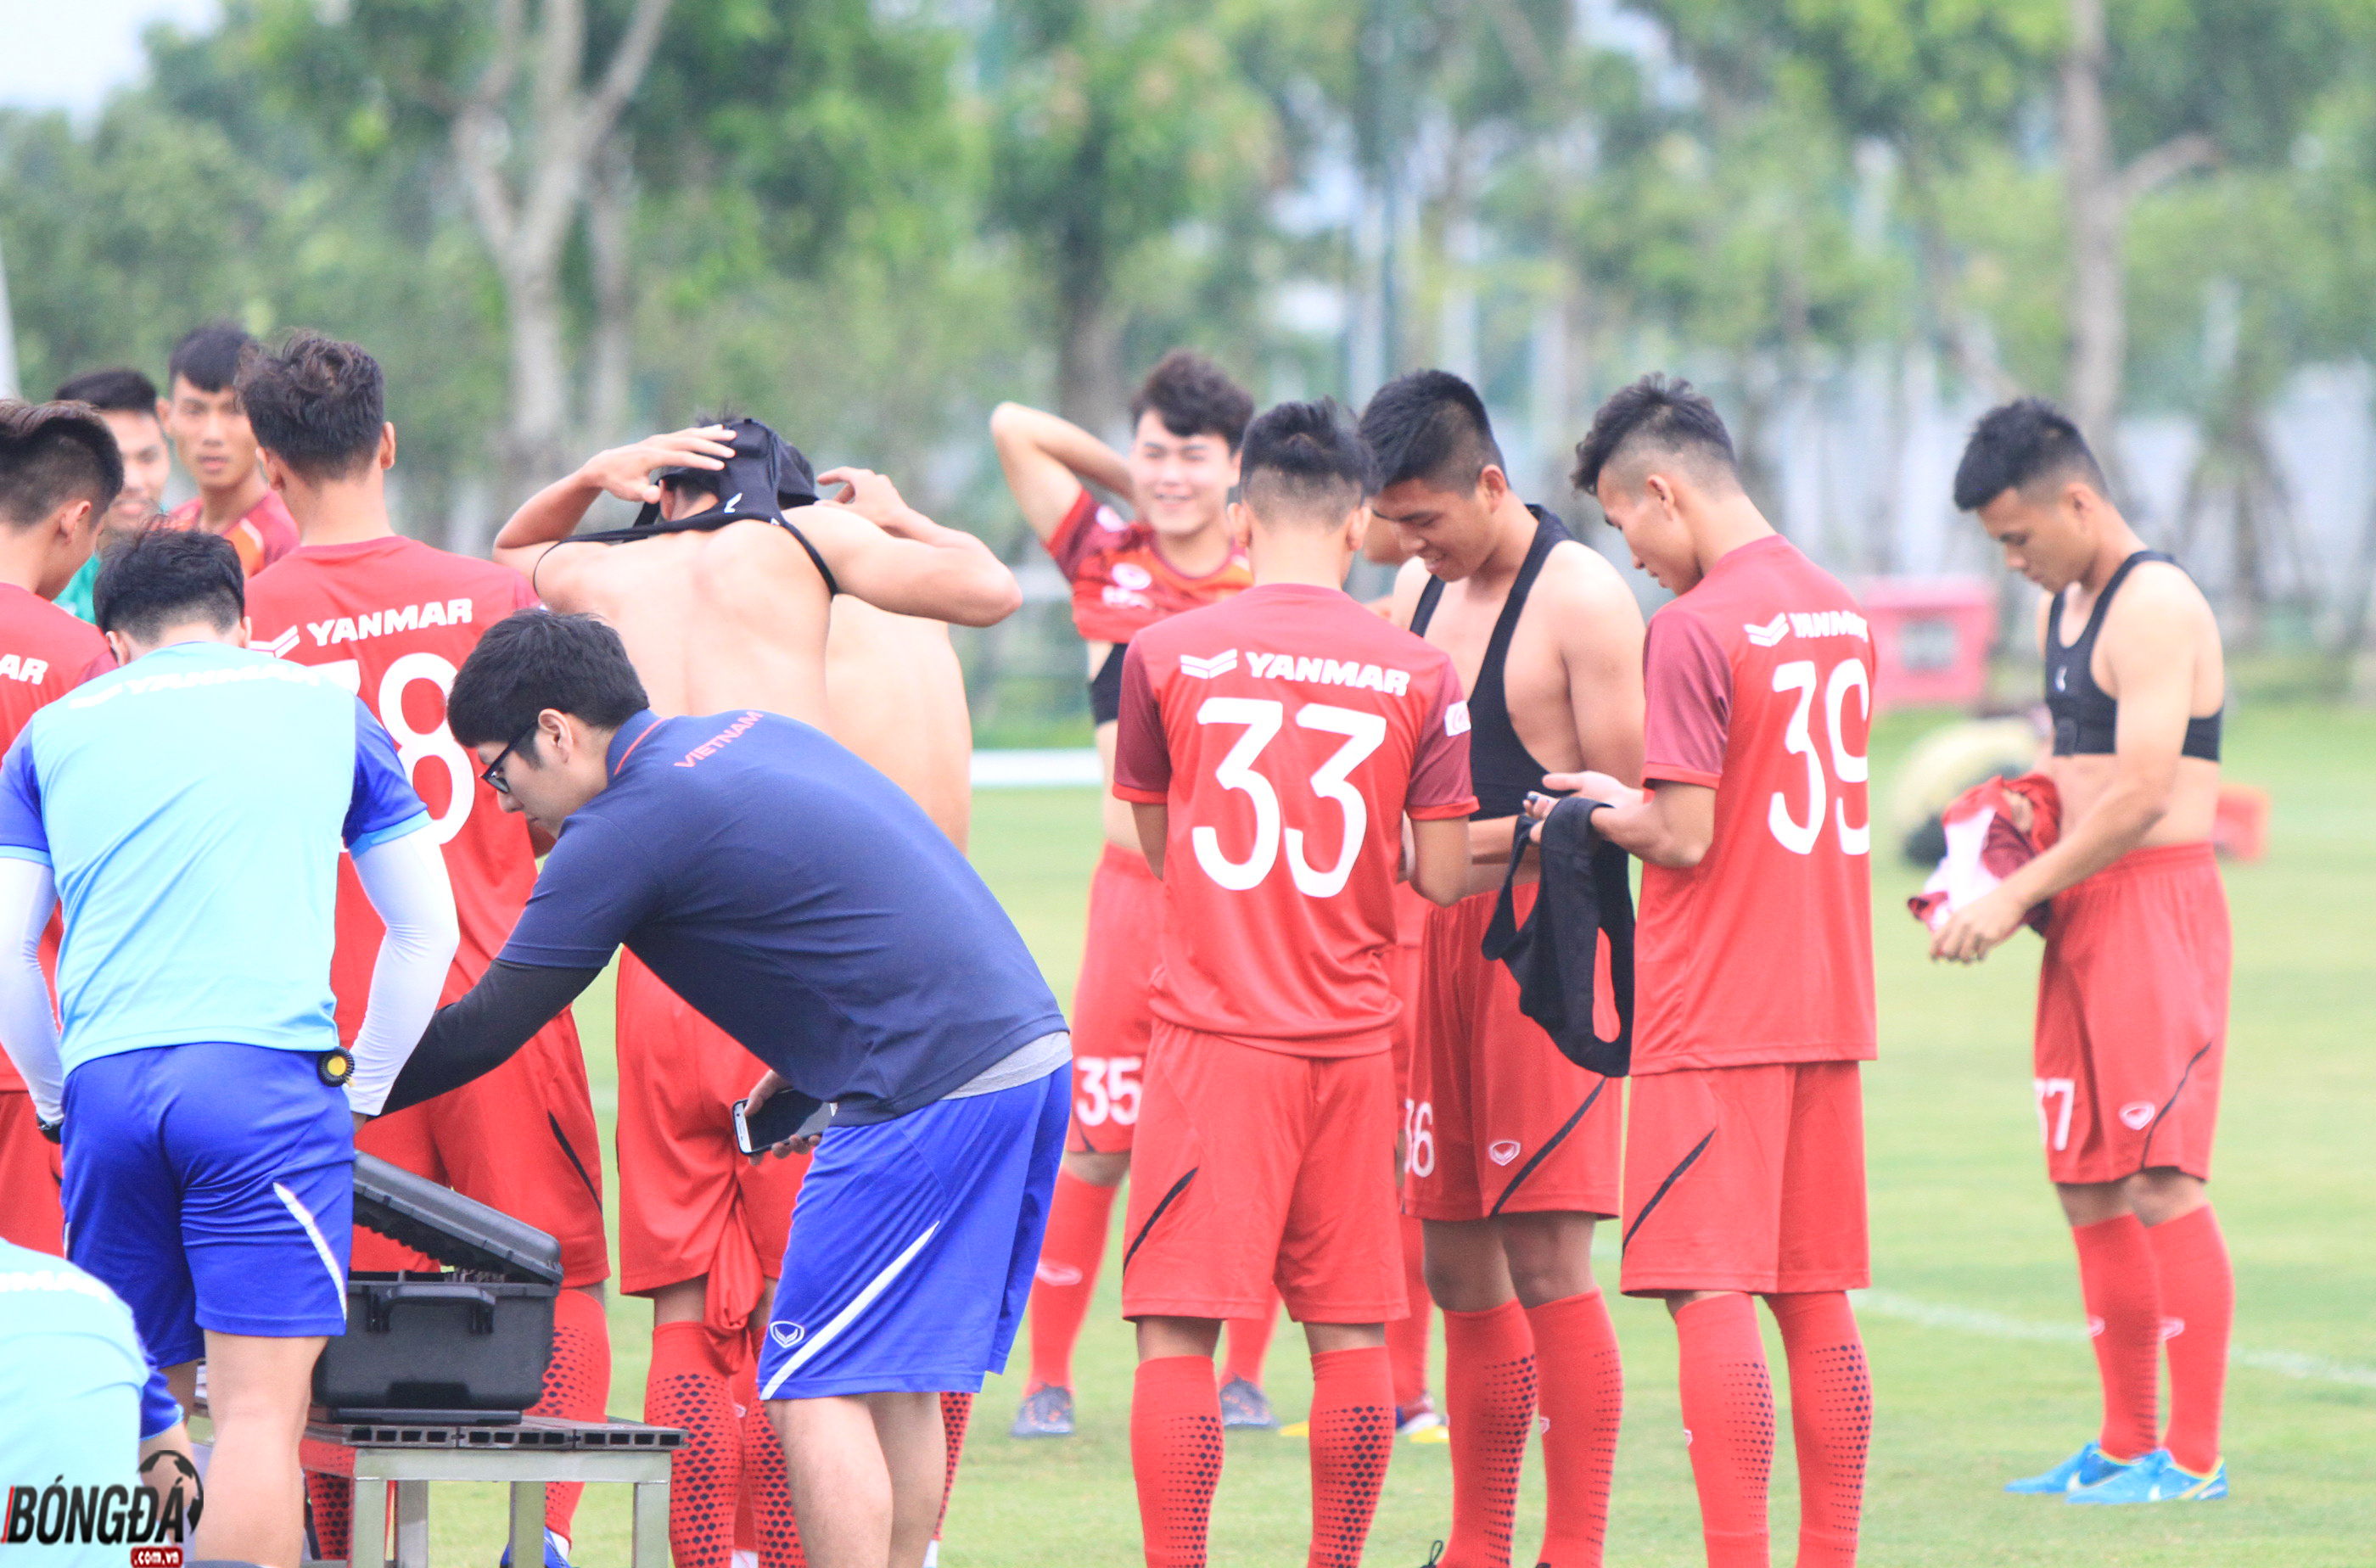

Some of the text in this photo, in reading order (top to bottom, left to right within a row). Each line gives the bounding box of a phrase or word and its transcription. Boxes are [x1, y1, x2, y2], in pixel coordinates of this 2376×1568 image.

[306, 597, 473, 647] YANMAR
[1245, 652, 1411, 697] YANMAR
[305, 652, 476, 853] 8
[674, 710, 764, 768] VIETNAM
[1768, 658, 1871, 855] 39
[1192, 697, 1387, 899] 33
[1076, 1056, 1144, 1126] 35
